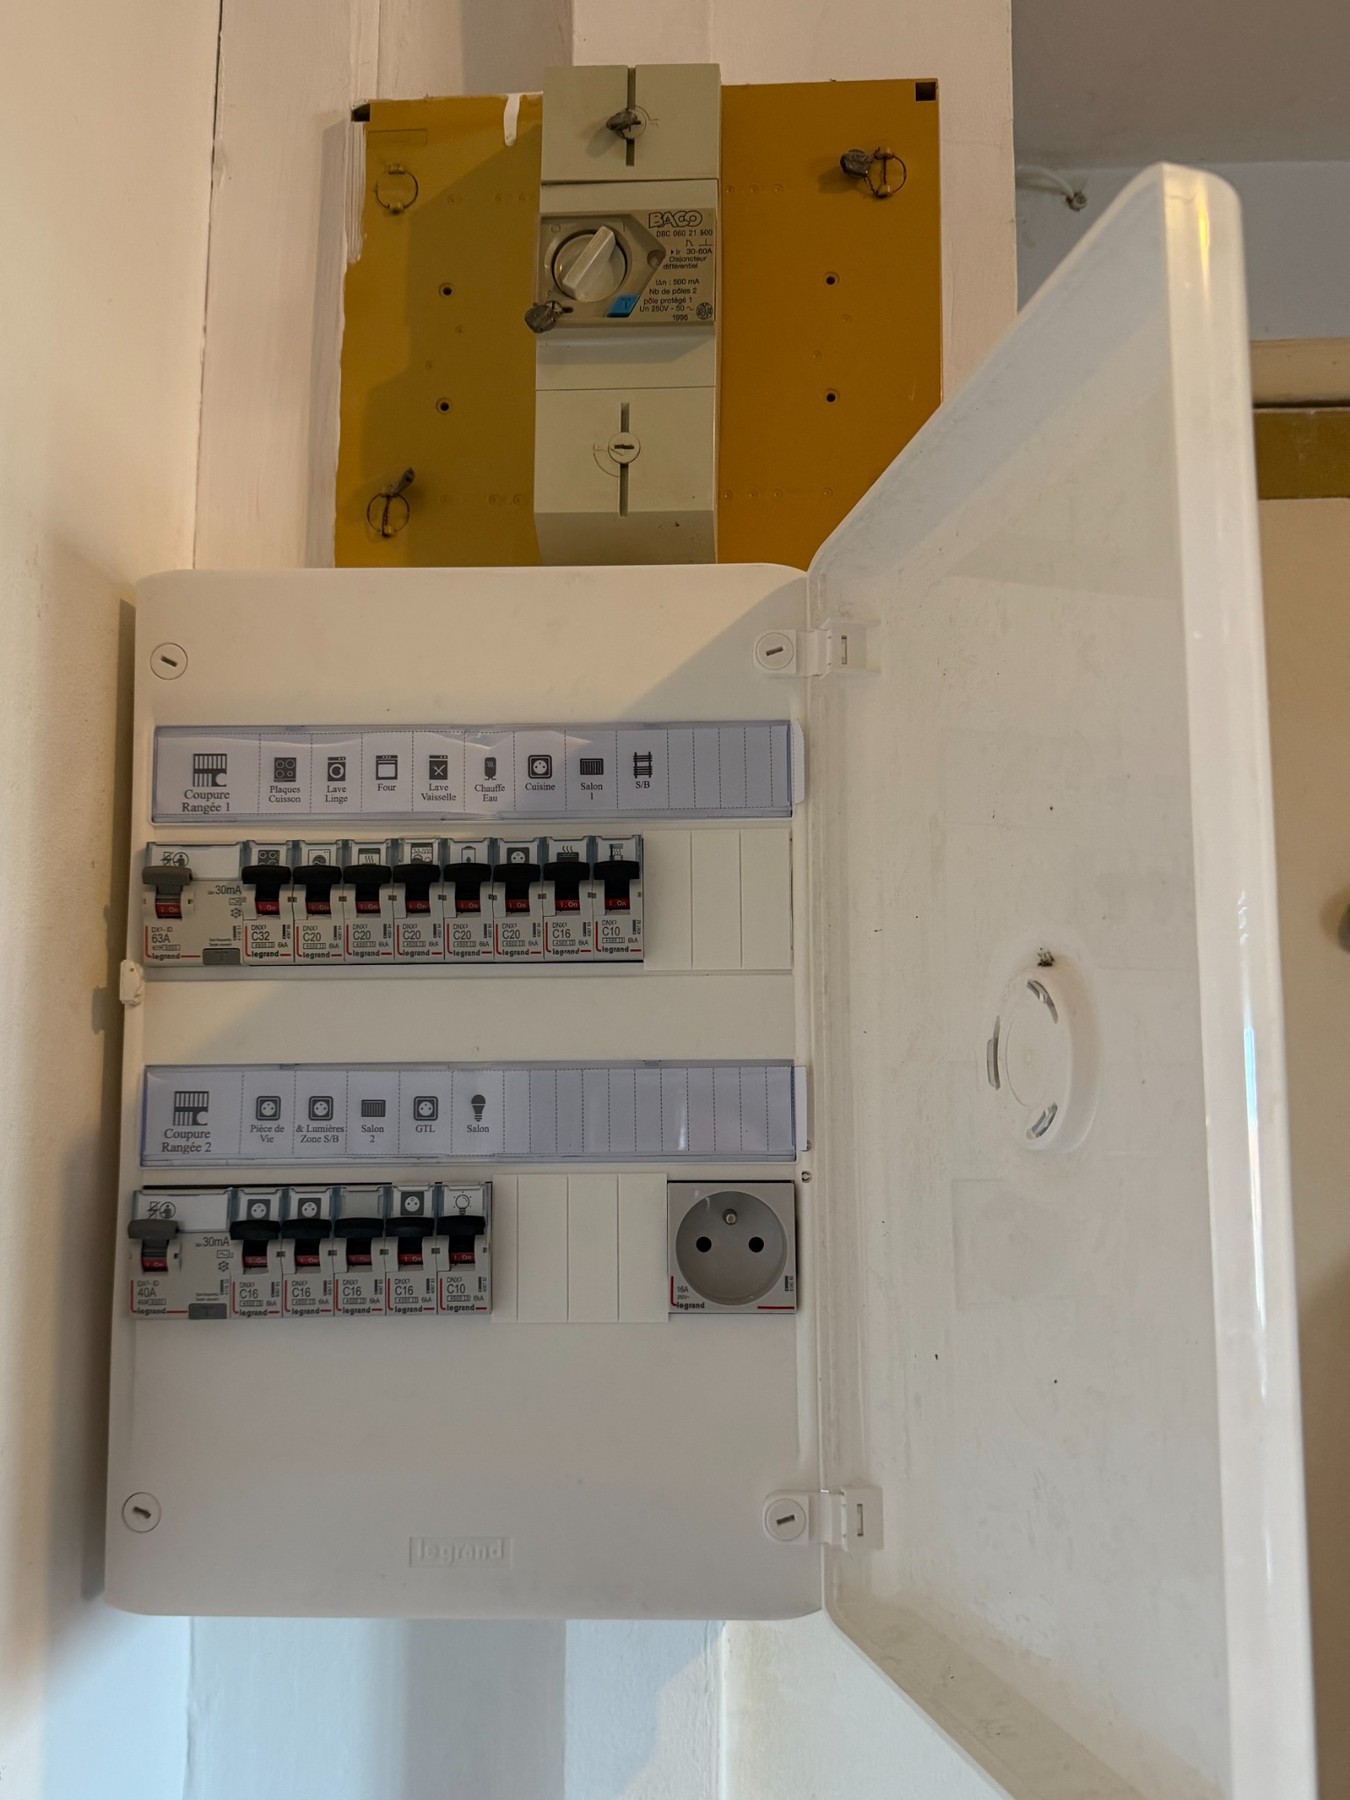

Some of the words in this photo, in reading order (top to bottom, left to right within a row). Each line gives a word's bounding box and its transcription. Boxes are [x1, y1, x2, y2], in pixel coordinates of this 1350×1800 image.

[648, 210, 702, 228] BACO
[474, 784, 505, 792] Chauffe
[525, 783, 555, 791] Cuisine
[581, 782, 603, 791] Salon
[636, 781, 650, 789] S/B
[184, 789, 230, 801] Coupure
[270, 786, 301, 795] Plaques
[269, 795, 301, 803] Cuisson
[325, 795, 348, 804] Linge
[421, 793, 456, 801] Vaisselle
[483, 794, 498, 802] Eau
[182, 802, 221, 814] Rangée
[226, 802, 230, 812] 1
[215, 885, 242, 894] 30mA
[252, 931, 270, 941] C32
[353, 931, 371, 940] C20
[403, 931, 420, 940] C20
[453, 931, 471, 940] C20
[502, 930, 520, 939] C20
[552, 929, 571, 938] C16
[602, 927, 620, 936] C10
[152, 934, 170, 943] 63A
[303, 932, 321, 942] C20
[251, 950, 279, 958] legrand
[352, 950, 379, 958] legrand
[502, 949, 529, 957] legrand
[553, 948, 579, 956] legrand
[602, 946, 629, 954] legrand
[152, 953, 180, 961] legrand
[303, 951, 330, 959] legrand
[250, 1124, 273, 1132] Pièce
[274, 1124, 284, 1132] de
[306, 1124, 344, 1133] Lumières
[361, 1124, 384, 1133] Salon
[416, 1125, 435, 1133] GTL
[466, 1124, 490, 1133] Salon
[164, 1128, 211, 1140] Coupure
[260, 1135, 274, 1143] Vie
[301, 1135, 322, 1143] Zone
[323, 1135, 339, 1143] S/B
[370, 1135, 375, 1143] 2
[162, 1142, 201, 1154] Rangée
[205, 1142, 212, 1152] 2
[203, 1237, 230, 1246] 30mA
[138, 1288, 156, 1298] 40A
[292, 1288, 311, 1297] C16
[343, 1287, 361, 1296] C16
[395, 1286, 413, 1295] C16
[447, 1284, 466, 1293] C10
[240, 1289, 258, 1298] C16
[395, 1306, 422, 1314] legrand
[447, 1304, 474, 1312] legrand
[676, 1302, 705, 1310] legrand
[137, 1307, 166, 1315] legrand
[240, 1309, 268, 1317] legrand
[292, 1308, 319, 1316] legrand
[342, 1307, 370, 1315] legrand
[416, 1539, 504, 1564] legrand
